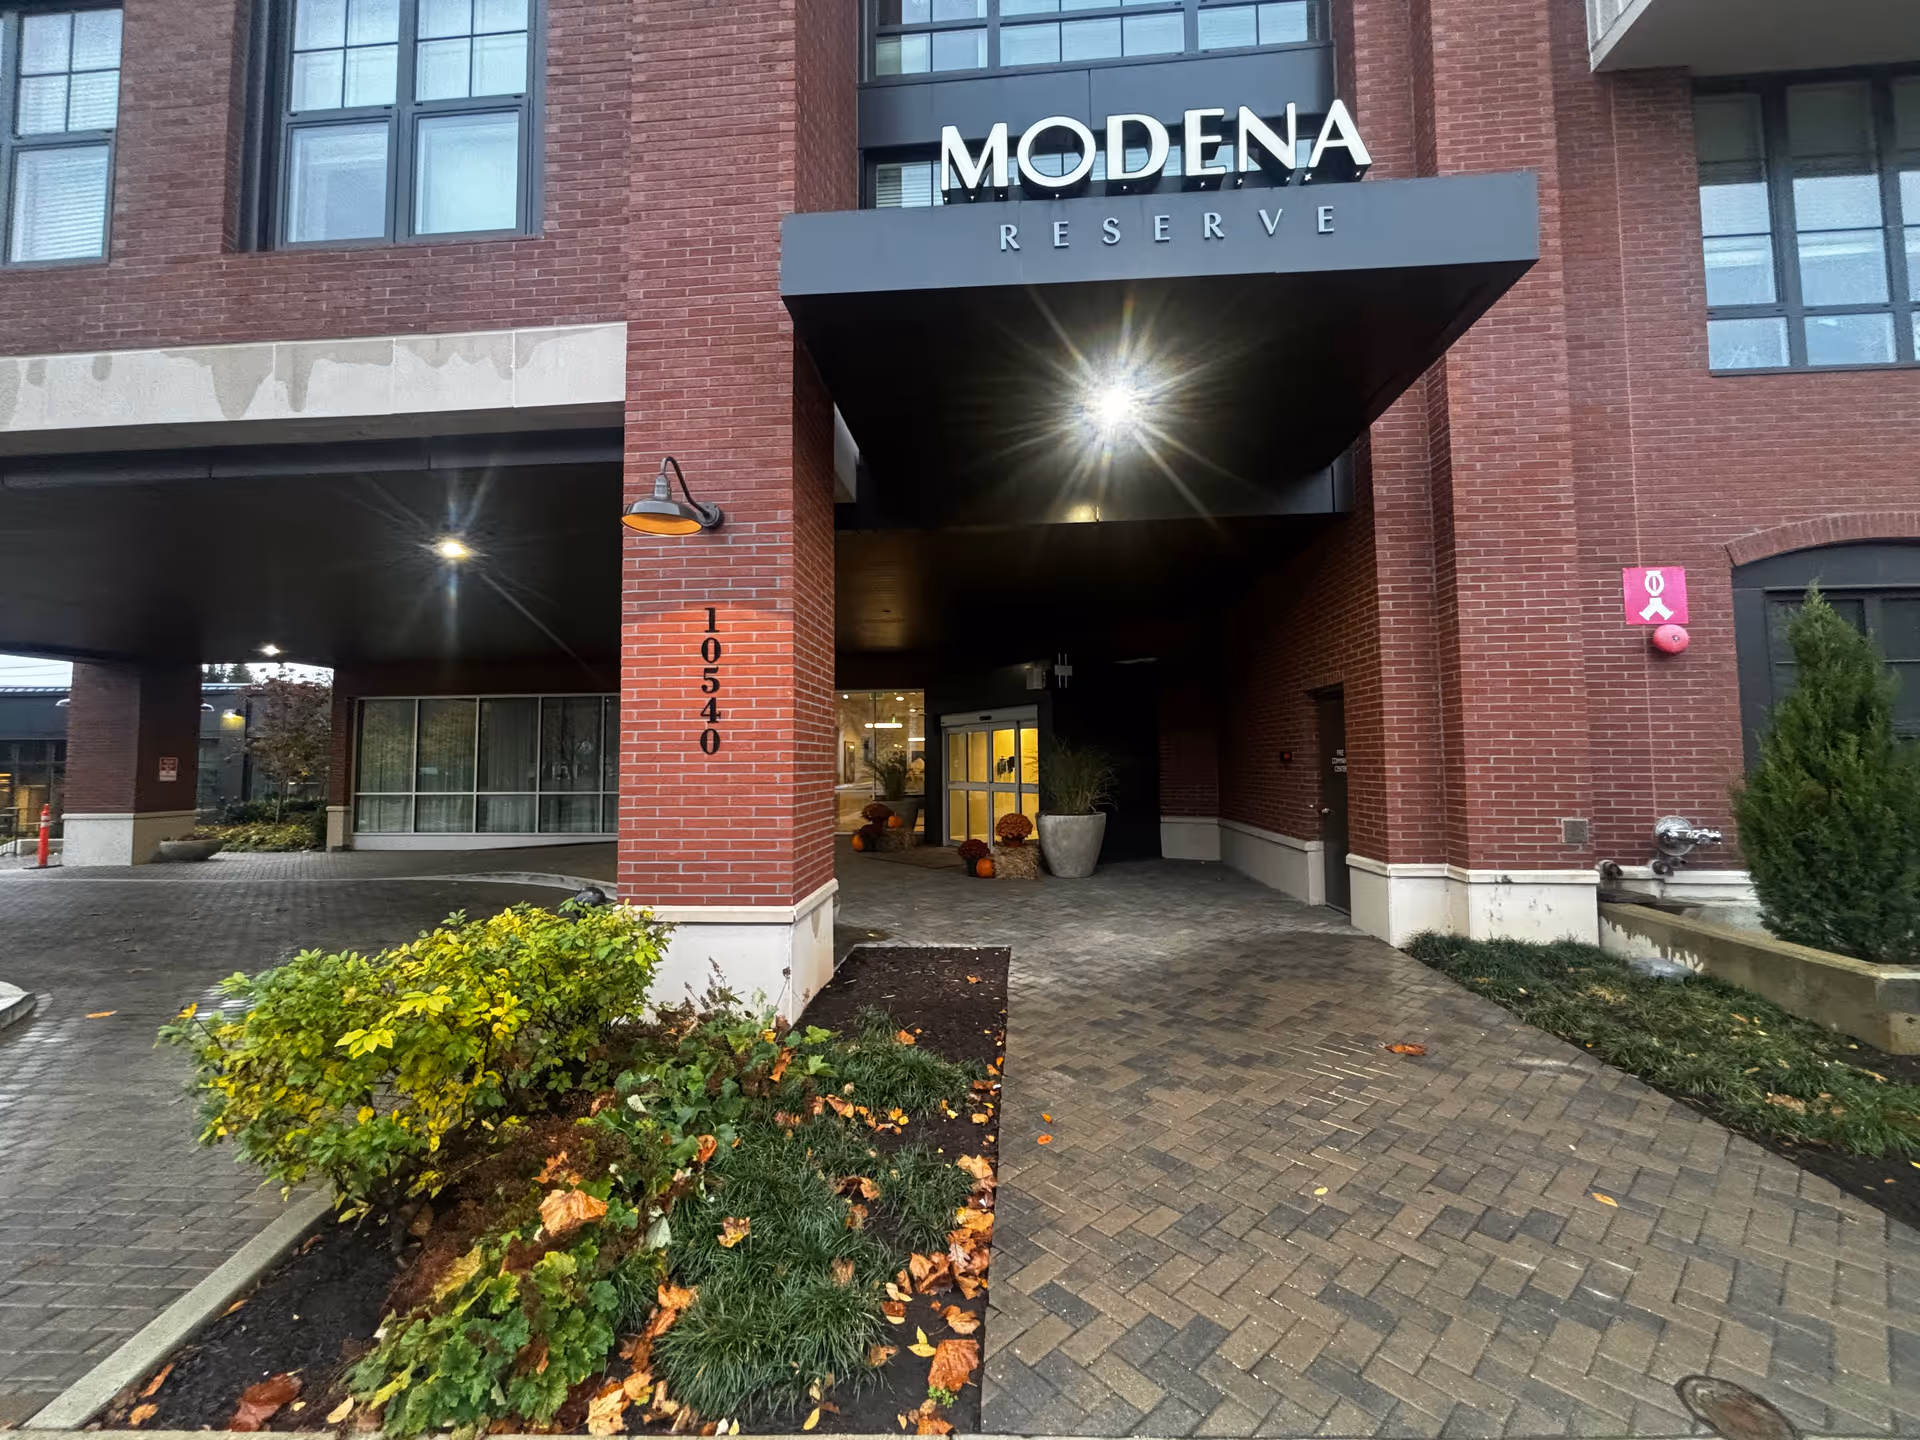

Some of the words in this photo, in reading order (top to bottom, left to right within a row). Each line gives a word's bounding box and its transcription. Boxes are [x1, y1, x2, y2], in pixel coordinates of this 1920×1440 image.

[941, 99, 1372, 193] MODENA
[1000, 205, 1335, 250] RESERVE
[700, 607, 722, 755] 10540
